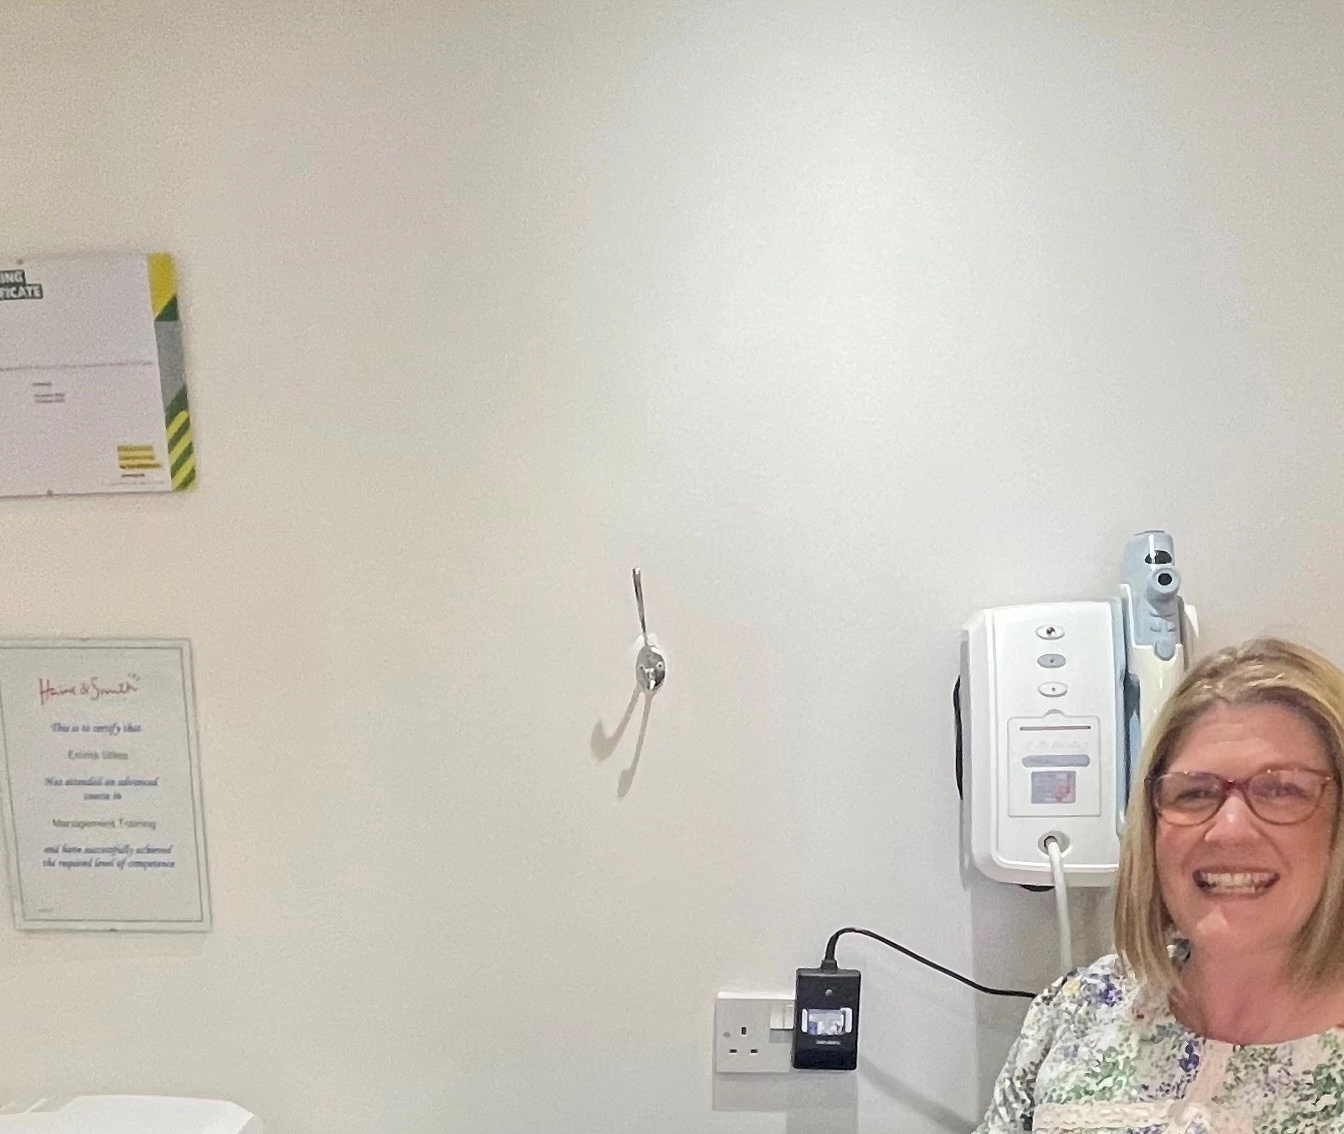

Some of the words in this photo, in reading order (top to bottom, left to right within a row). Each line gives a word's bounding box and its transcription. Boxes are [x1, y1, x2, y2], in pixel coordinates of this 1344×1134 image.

[50, 722, 70, 733] This
[71, 725, 80, 733] is
[81, 724, 91, 733] to
[92, 722, 121, 737] certify
[123, 723, 142, 733] that
[116, 776, 159, 787] advanced
[52, 819, 116, 830] Management
[118, 818, 157, 830] Training
[83, 844, 134, 857] successfully
[135, 844, 174, 854] achieved
[58, 858, 93, 870] required
[95, 857, 115, 867] level
[116, 858, 128, 870] of
[127, 860, 176, 871] competence
